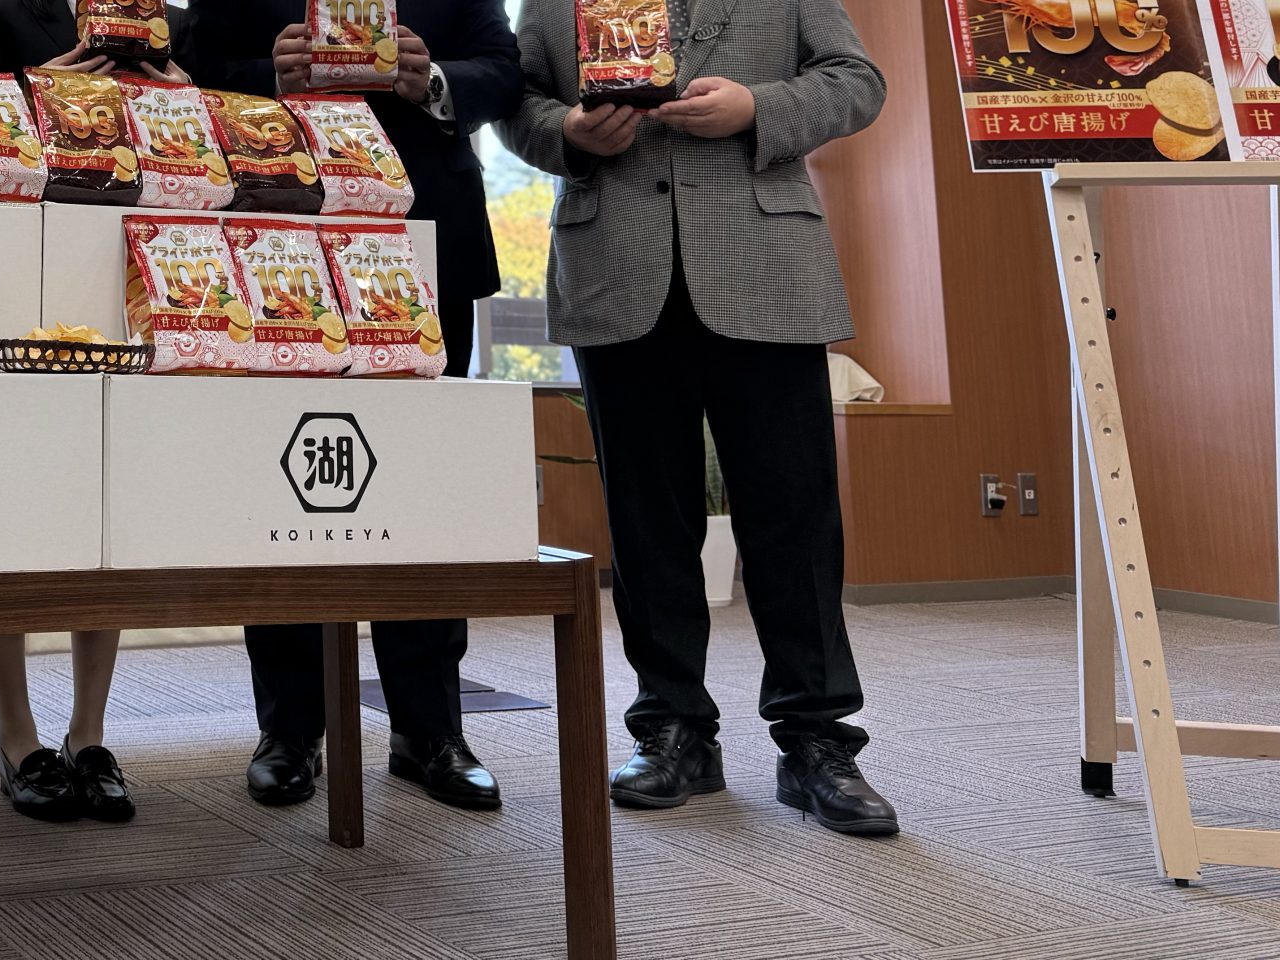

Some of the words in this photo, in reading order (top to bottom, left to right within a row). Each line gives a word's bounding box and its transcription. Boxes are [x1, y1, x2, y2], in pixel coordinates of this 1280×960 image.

[979, 111, 1131, 135] 甘えび唐揚げ
[303, 436, 354, 491] 湖
[270, 529, 391, 541] KOIKEYA
